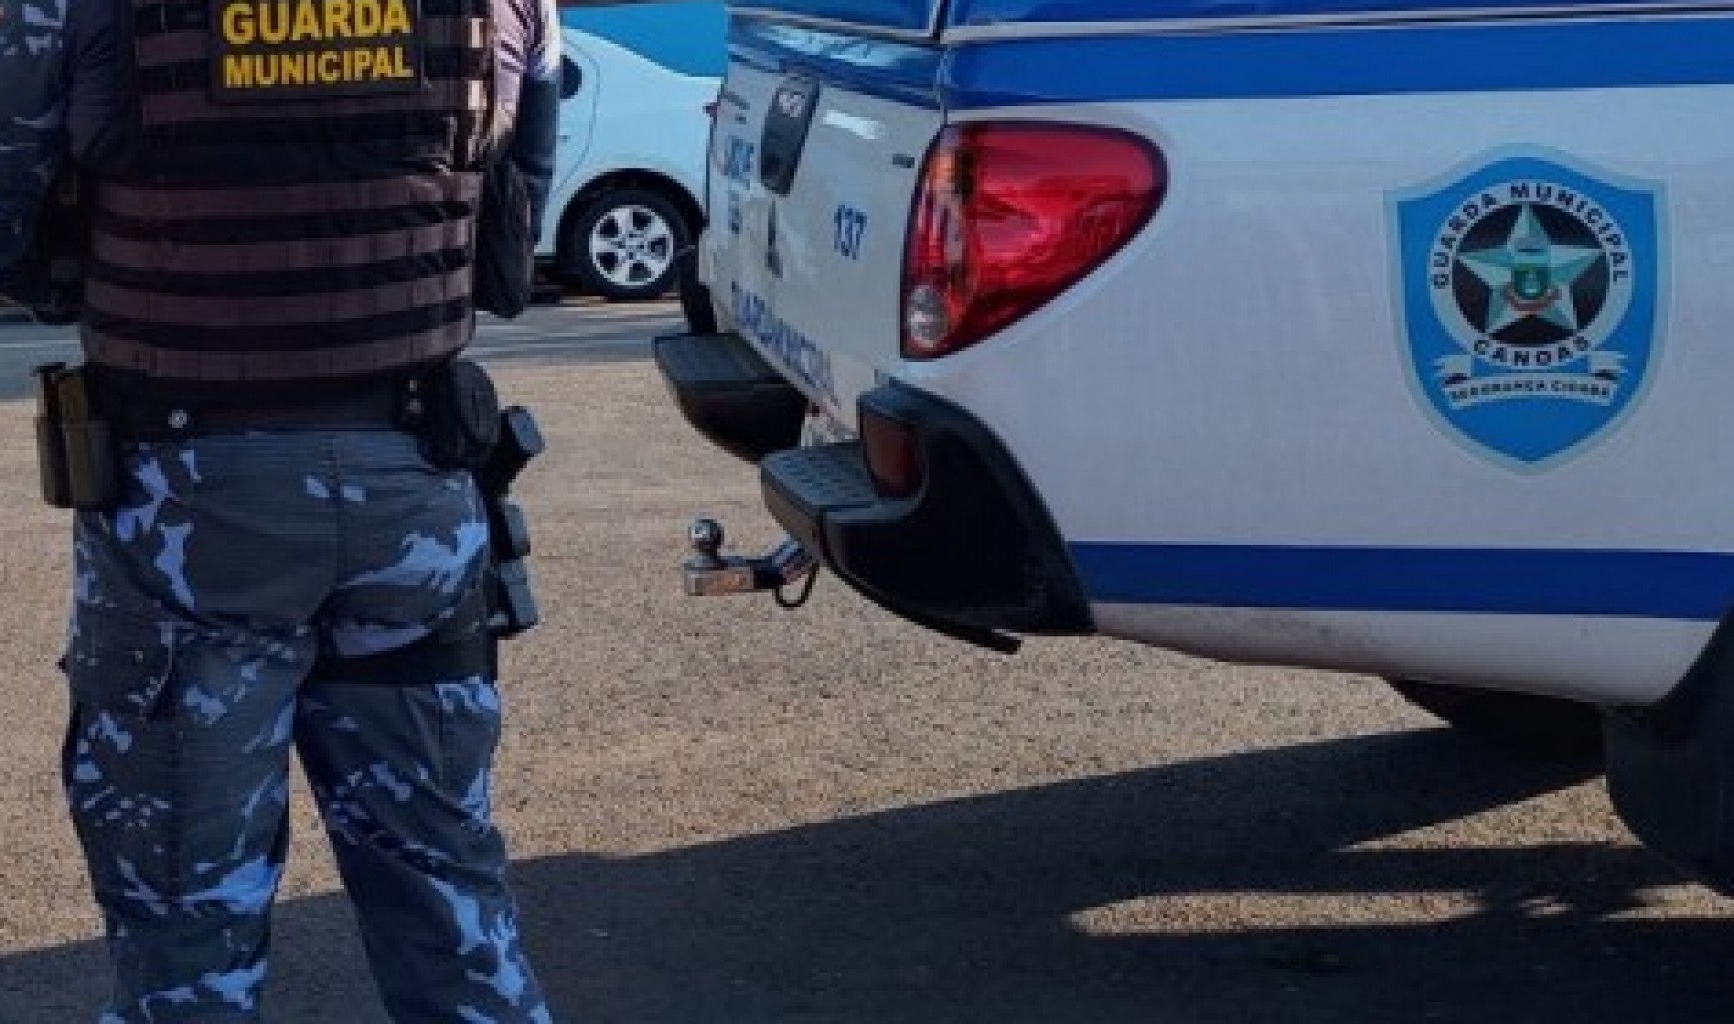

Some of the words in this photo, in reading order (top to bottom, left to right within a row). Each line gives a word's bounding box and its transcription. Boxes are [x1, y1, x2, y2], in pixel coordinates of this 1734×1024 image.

[223, 45, 415, 89] MUNICIPAL
[833, 204, 867, 261] 137
[1430, 192, 1498, 290] GUARDA
[1510, 182, 1629, 283] MUNICIPAL
[1473, 335, 1590, 367] CANOAS
